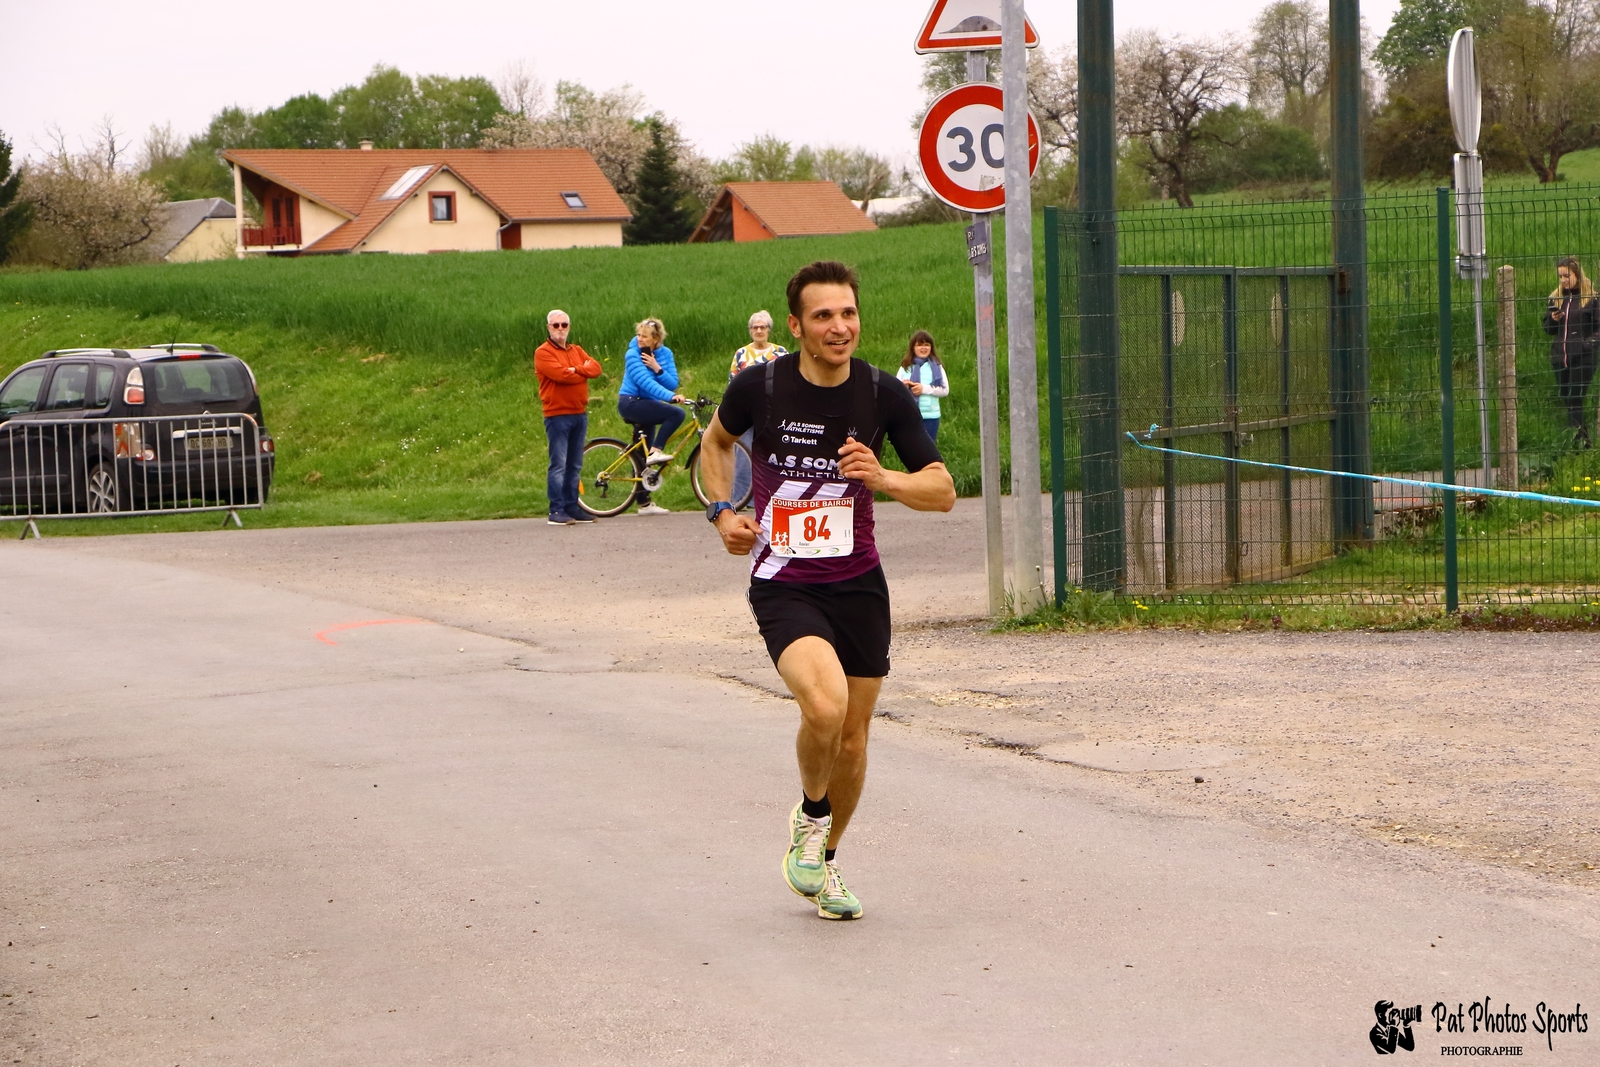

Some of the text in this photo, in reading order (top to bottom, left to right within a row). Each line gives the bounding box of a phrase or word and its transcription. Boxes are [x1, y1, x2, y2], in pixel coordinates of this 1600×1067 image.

[946, 123, 1005, 173] 30
[790, 436, 818, 446] Tarkett
[767, 452, 797, 468] A.S
[772, 498, 808, 508] COURSES
[822, 499, 852, 508] BAIRON
[803, 515, 831, 542] 84
